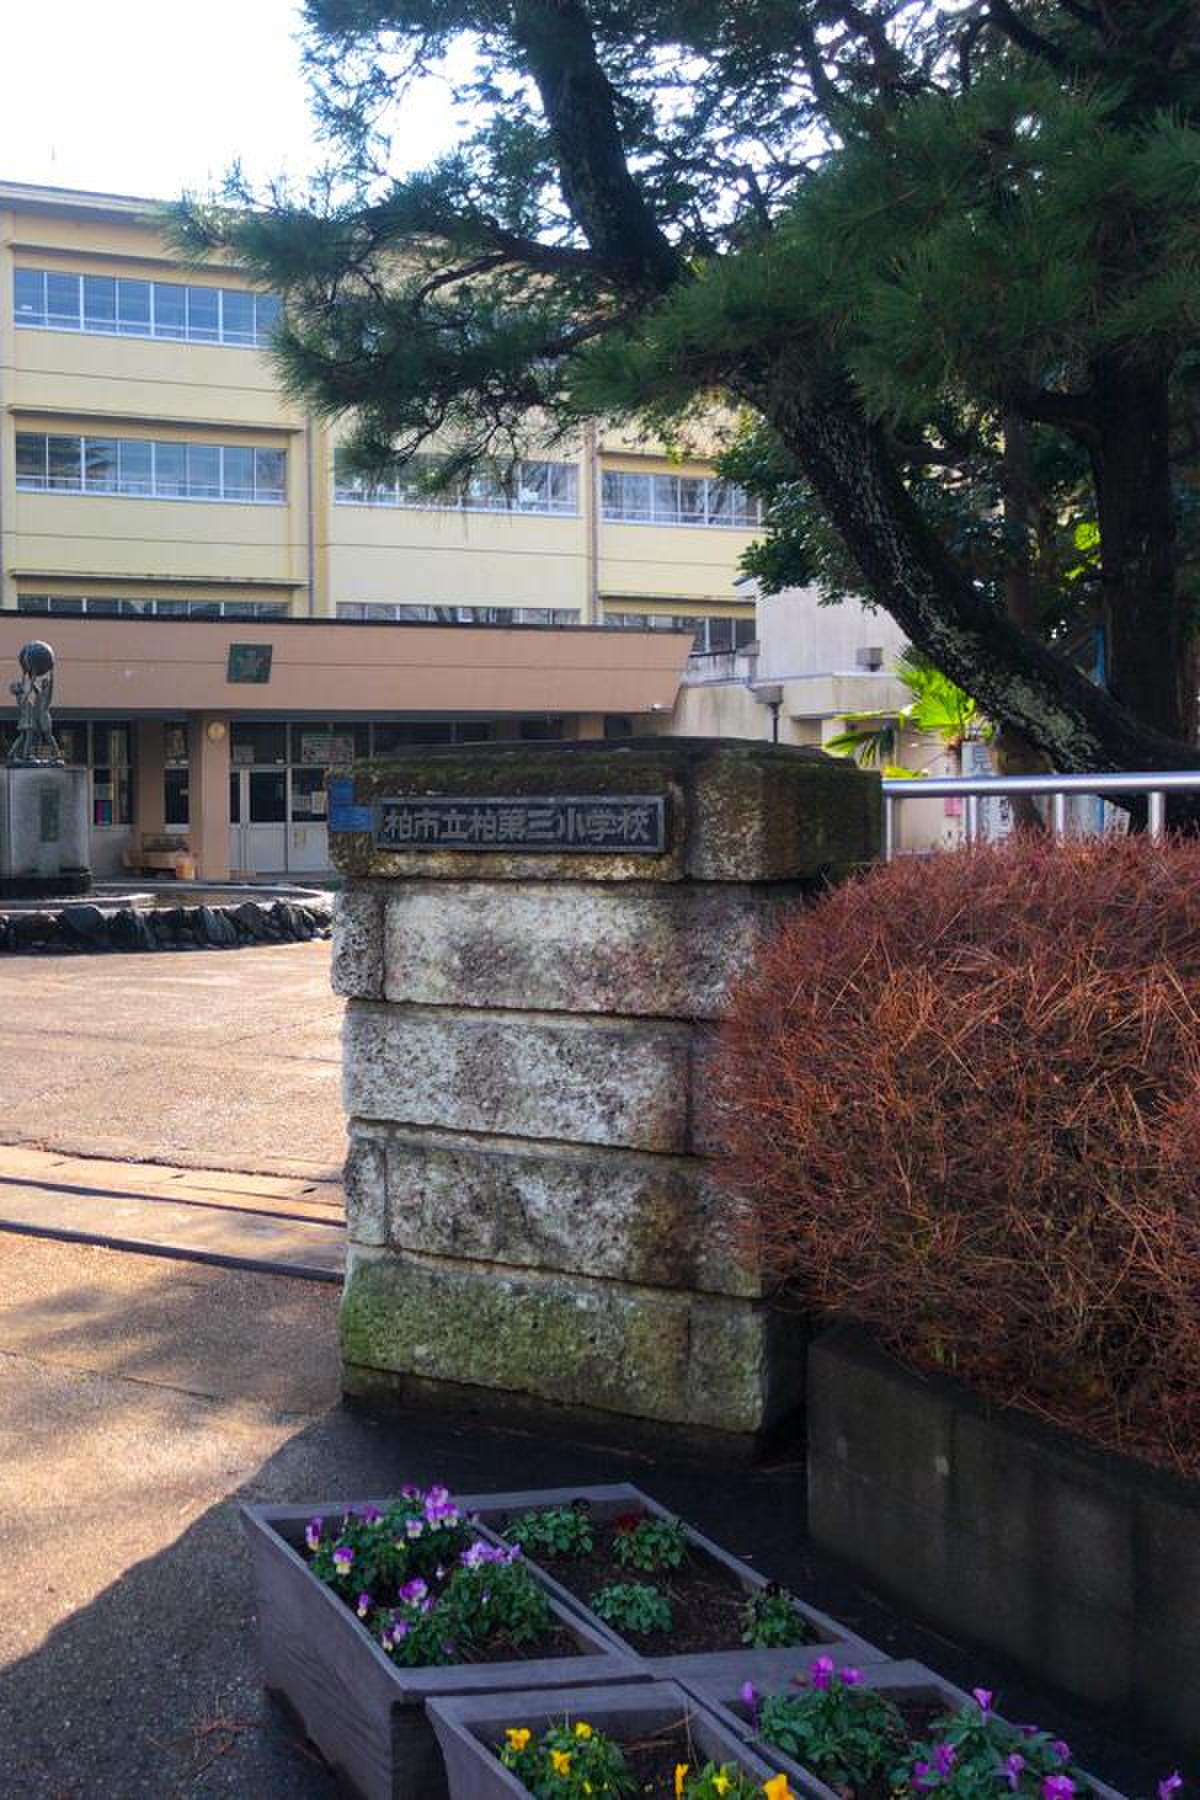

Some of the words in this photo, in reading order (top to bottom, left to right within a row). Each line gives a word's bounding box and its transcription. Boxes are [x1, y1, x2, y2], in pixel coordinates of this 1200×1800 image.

[384, 807, 651, 842] 柏市立柏第三小学校
